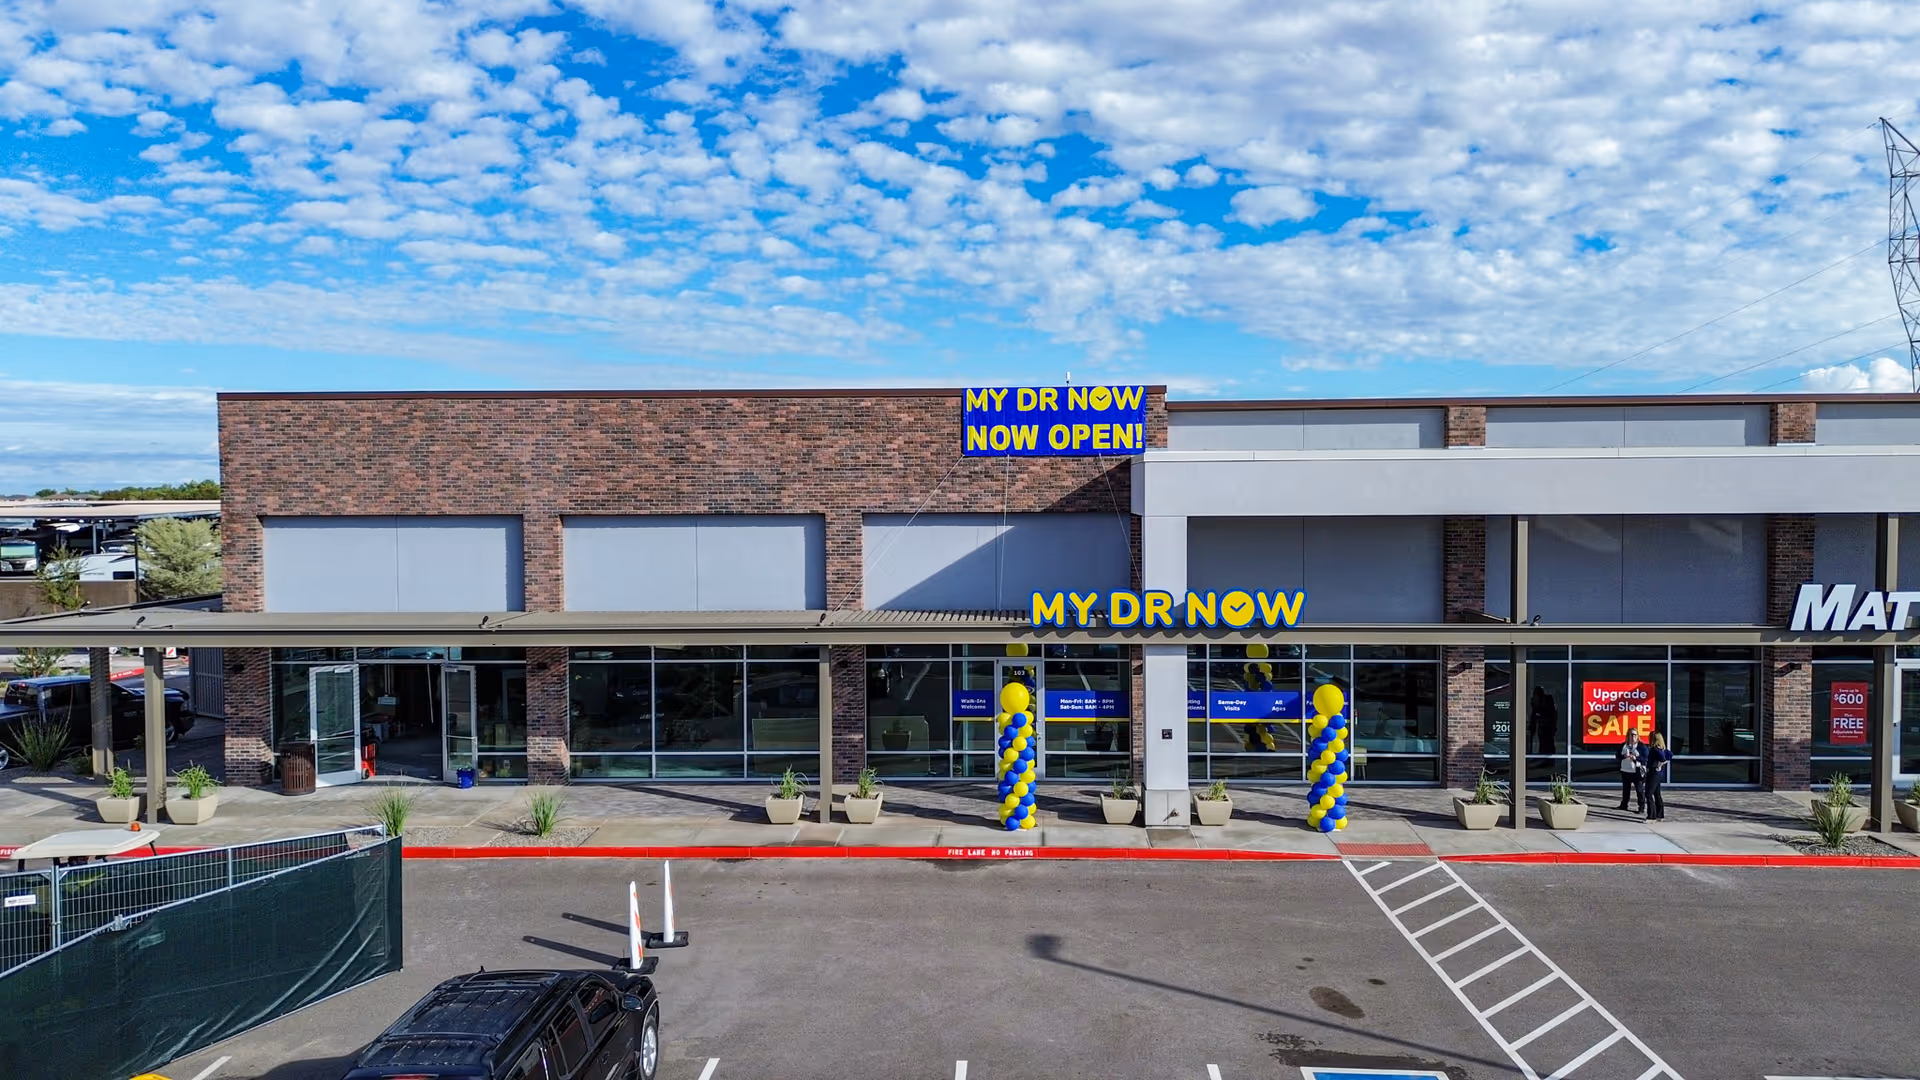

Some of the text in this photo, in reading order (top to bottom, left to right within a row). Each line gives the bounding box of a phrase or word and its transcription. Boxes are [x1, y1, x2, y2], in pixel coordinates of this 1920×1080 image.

[966, 386, 1144, 412] MY DR NOW
[967, 423, 1143, 451] NOW OPEN!
[1031, 590, 1305, 629] MY DR NOW
[1789, 583, 1920, 631] MAT
[1593, 688, 1647, 702] Upgrade
[1834, 693, 1864, 704] $600
[1587, 701, 1651, 714] Your Sleep
[1587, 714, 1652, 736] SALE
[1833, 718, 1864, 728] FREE
